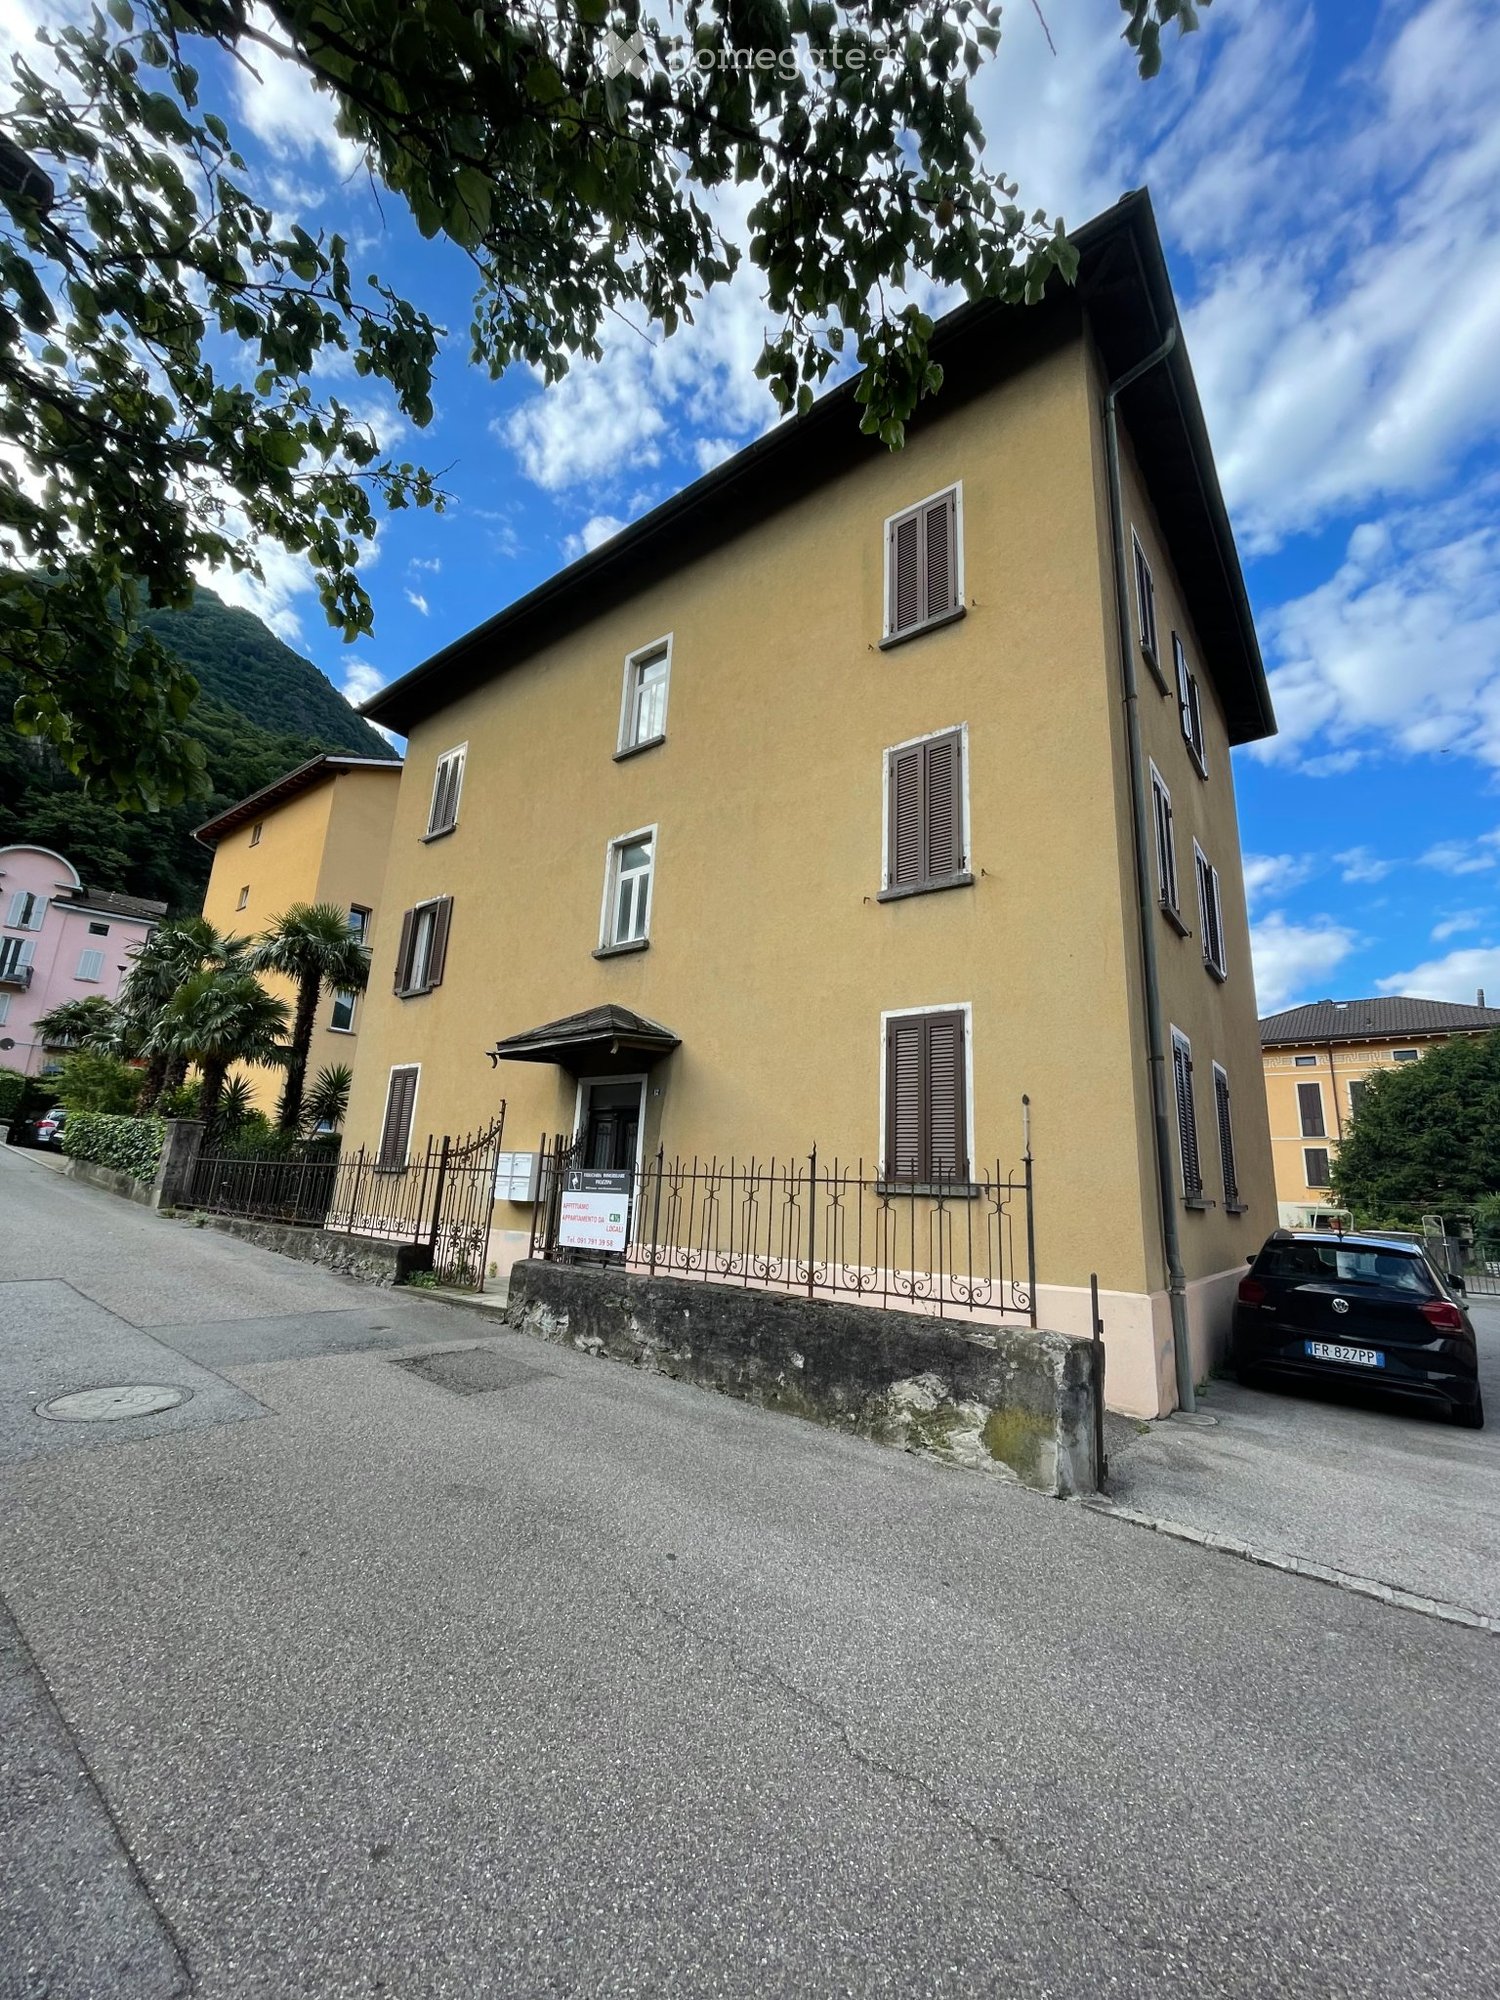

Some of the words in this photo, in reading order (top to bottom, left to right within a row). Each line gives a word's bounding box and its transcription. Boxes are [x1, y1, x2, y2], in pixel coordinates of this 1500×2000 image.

[562, 1214, 597, 1223] APPARTAMENTO
[606, 1225, 624, 1233] LOCALI
[1313, 1343, 1329, 1356] FR
[1334, 1346, 1375, 1363] 827PP
